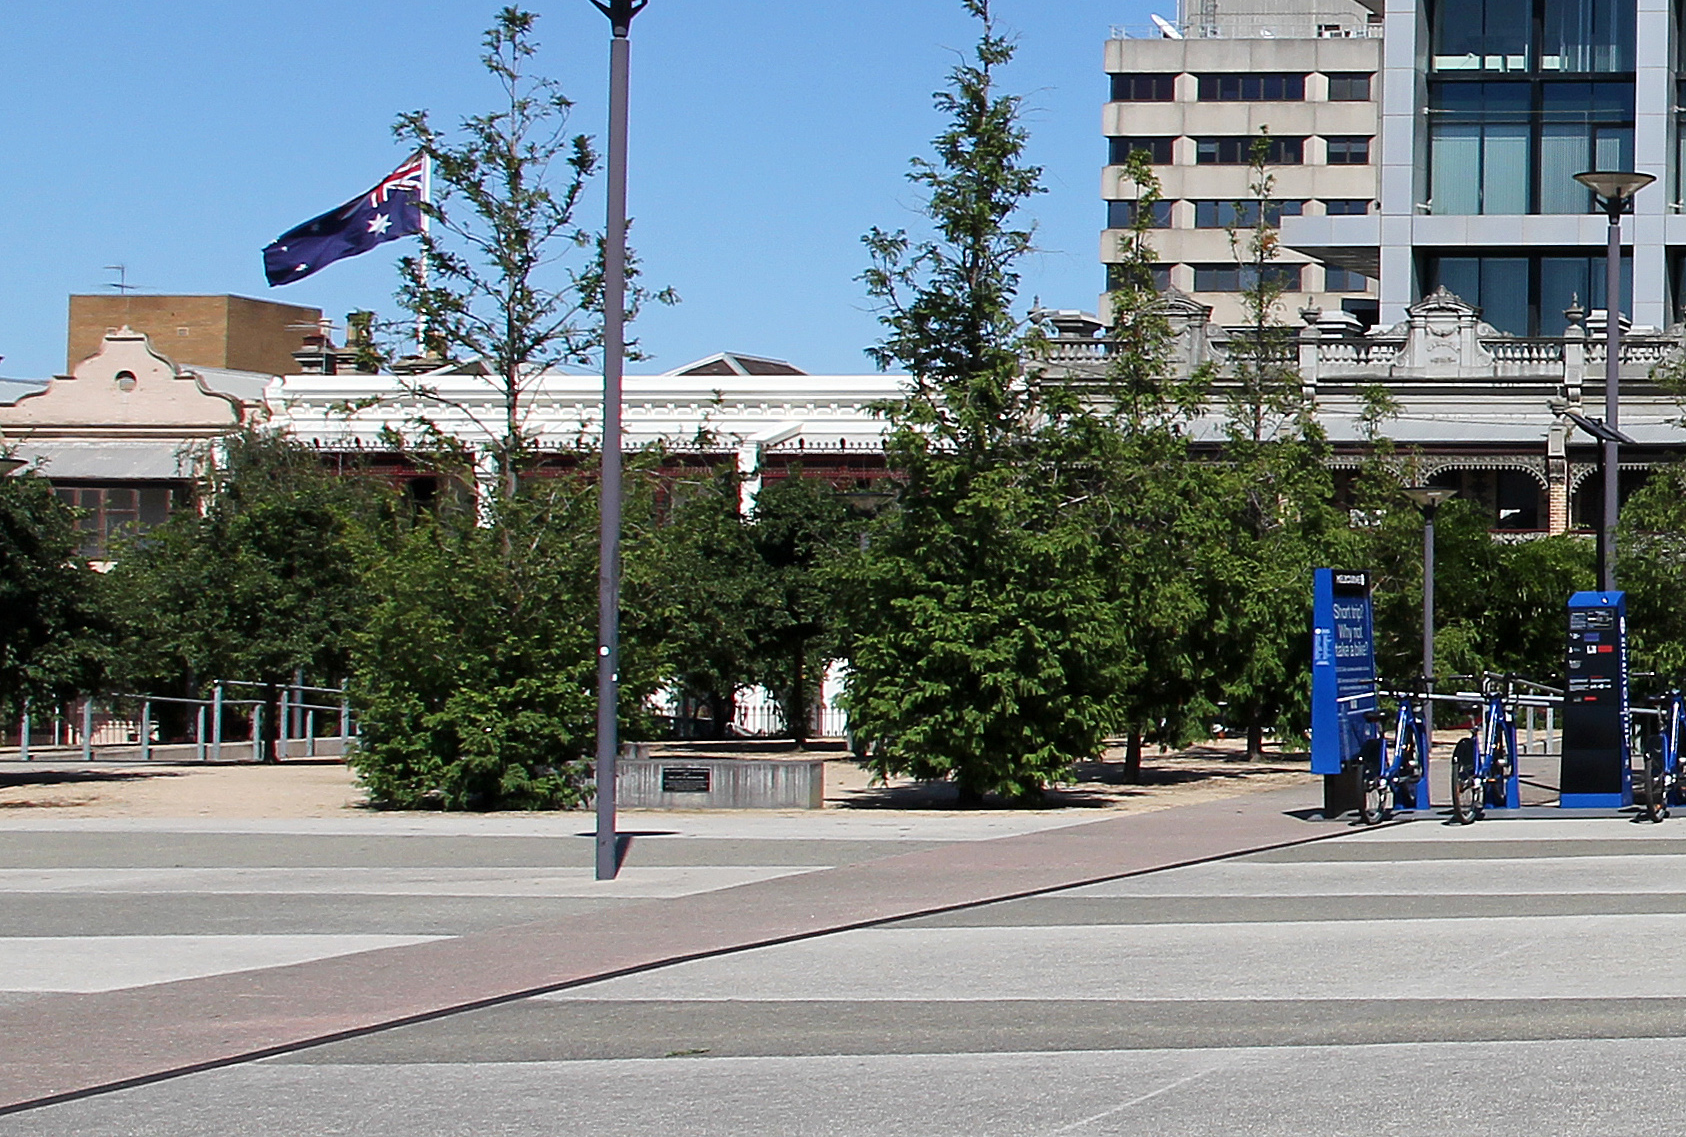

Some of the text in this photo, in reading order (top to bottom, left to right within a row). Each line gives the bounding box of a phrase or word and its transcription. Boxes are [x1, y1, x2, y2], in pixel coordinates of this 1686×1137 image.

[1333, 603, 1364, 622] Short trip?
[1338, 624, 1364, 642] Why not
[1335, 642, 1350, 657] take
[1354, 641, 1368, 657] bike?
